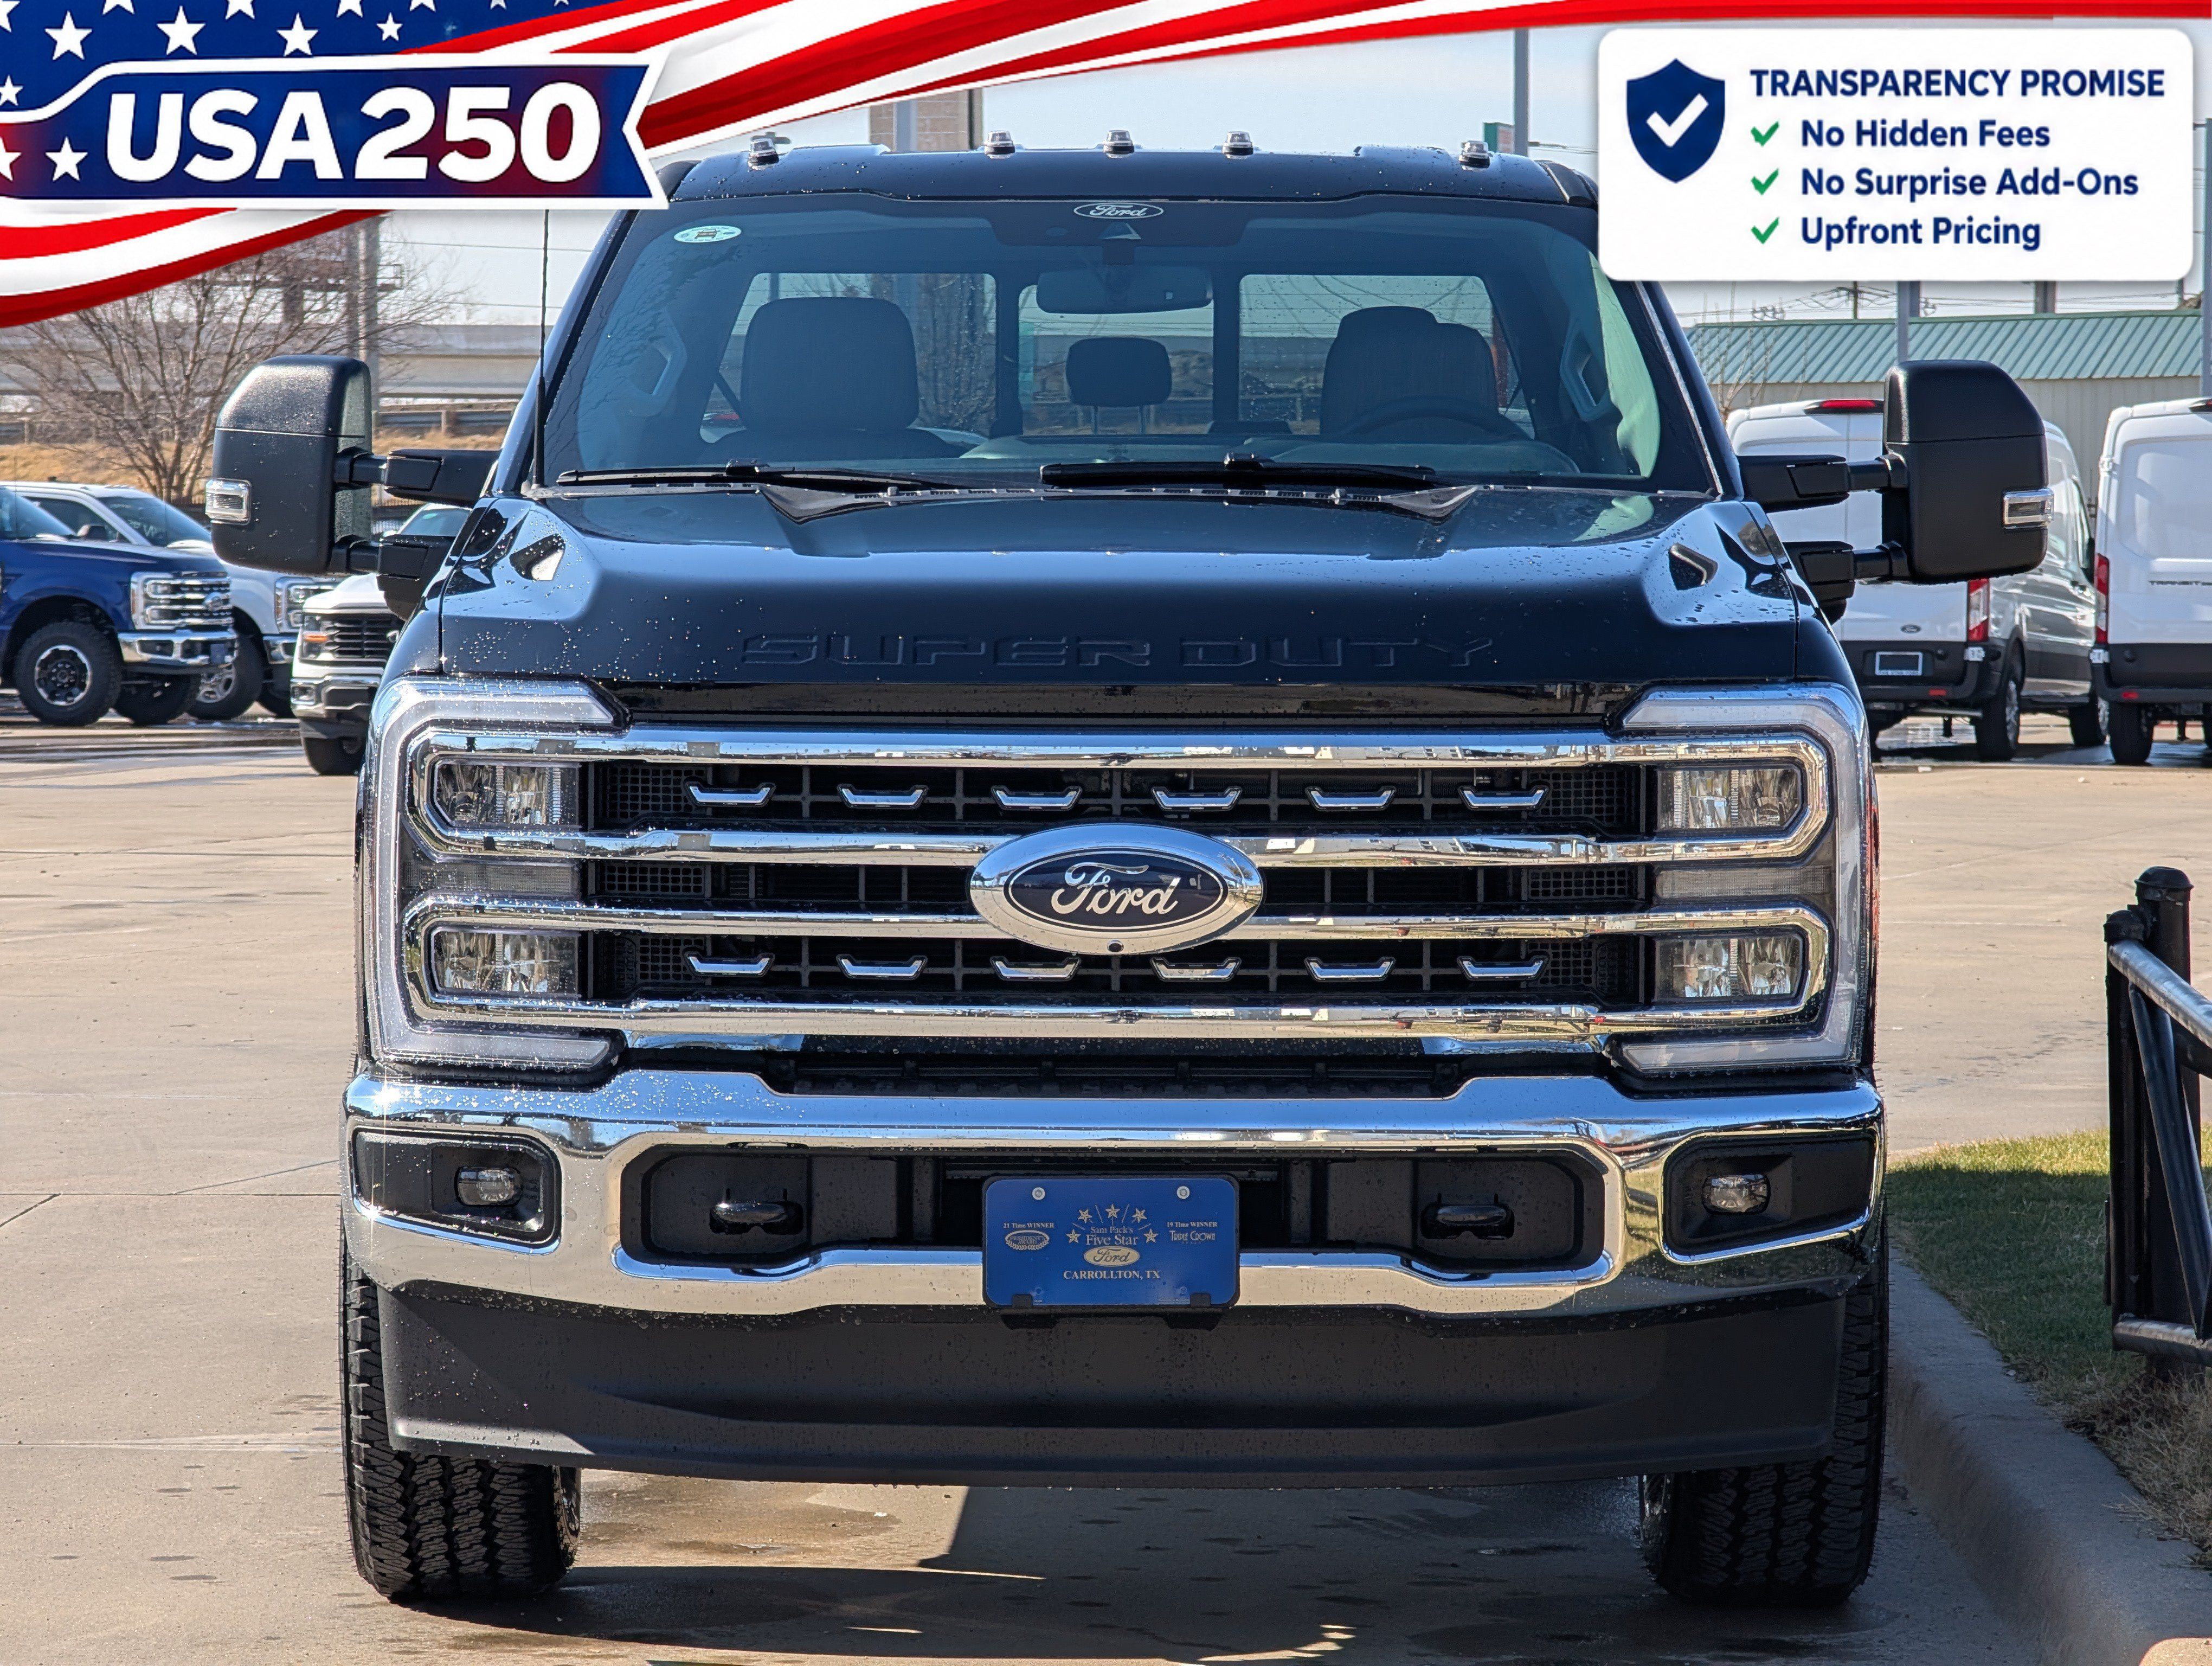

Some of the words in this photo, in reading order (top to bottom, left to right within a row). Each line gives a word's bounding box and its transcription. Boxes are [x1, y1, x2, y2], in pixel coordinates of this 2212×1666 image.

[1090, 205, 1148, 216] Ford
[741, 635, 1150, 666] SUPER
[1179, 635, 1493, 667] DUTY
[1051, 862, 1181, 915] Ford
[1110, 1226, 1134, 1234] Pack's
[1086, 1234, 1111, 1245] Five
[1115, 1234, 1139, 1245] Star
[1093, 1248, 1130, 1263] Ford
[1063, 1270, 1143, 1280] CARROLLTON,
[1145, 1270, 1161, 1279] TX
